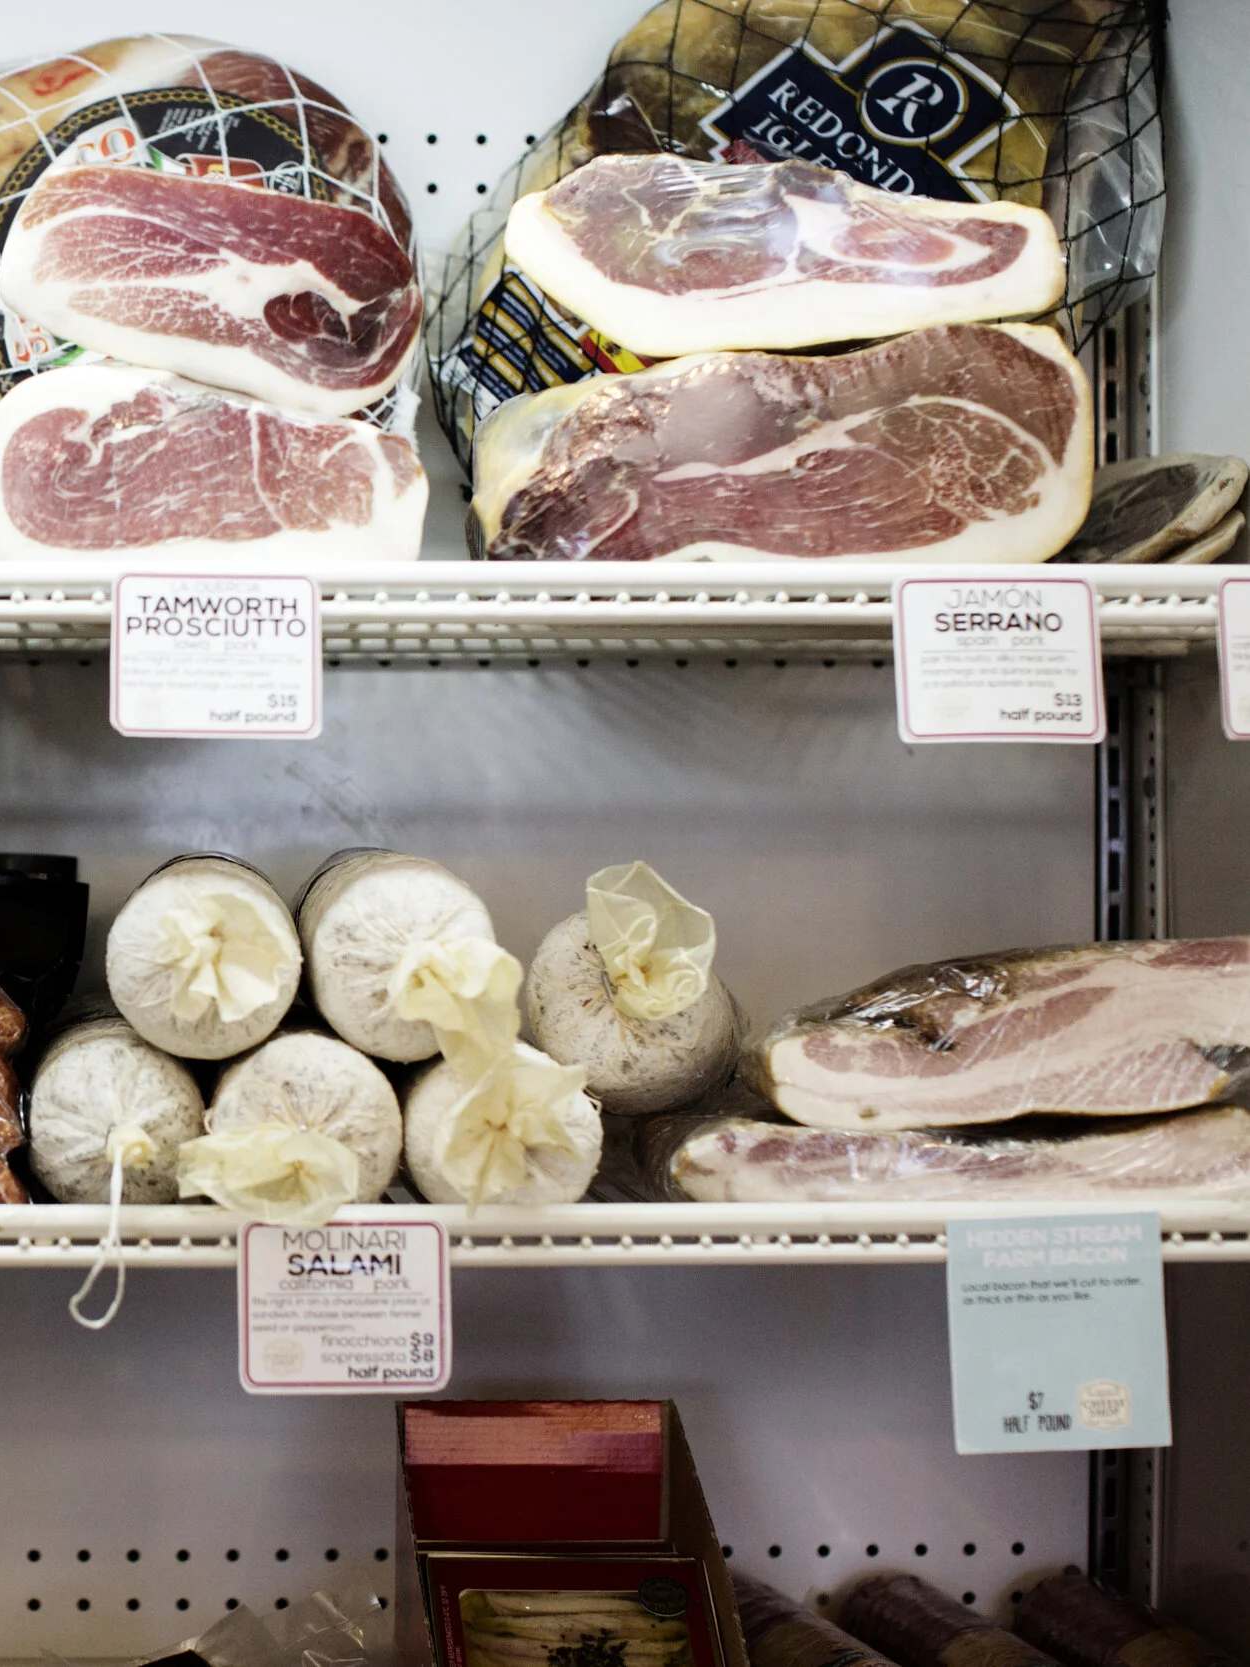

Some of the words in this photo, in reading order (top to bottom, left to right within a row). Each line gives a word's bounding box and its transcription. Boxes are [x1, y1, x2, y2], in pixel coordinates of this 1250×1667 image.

[767, 78, 918, 197] REDOND
[137, 596, 298, 616] TAMWORTH
[946, 584, 1042, 609] JAMÓN
[126, 616, 306, 637] PROSCIUTTO
[935, 612, 1063, 632] SERRANO
[956, 635, 999, 649] spain
[1011, 635, 1045, 648] pork
[267, 693, 298, 708] $15
[1054, 692, 1082, 707] $13
[209, 709, 241, 722] half
[244, 710, 297, 724] pound
[999, 708, 1030, 721] half
[1033, 709, 1083, 723] pound
[283, 1230, 406, 1251] MOLINARI
[967, 1229, 1048, 1248] HIDDEN
[1053, 1224, 1143, 1245] STREAM
[288, 1254, 401, 1276] SALAMI
[983, 1249, 1045, 1268] FARM
[1049, 1246, 1128, 1267] BACON
[279, 1278, 354, 1291] california
[373, 1278, 411, 1292] pork
[962, 1282, 991, 1293] Local
[993, 1281, 1030, 1292] bacon
[410, 1332, 435, 1348] $9
[410, 1349, 435, 1364] $8
[348, 1366, 378, 1379] half
[382, 1366, 434, 1383] pound
[1028, 1391, 1045, 1411] $7
[1003, 1415, 1031, 1433] HALF
[1038, 1414, 1073, 1433] POUND
